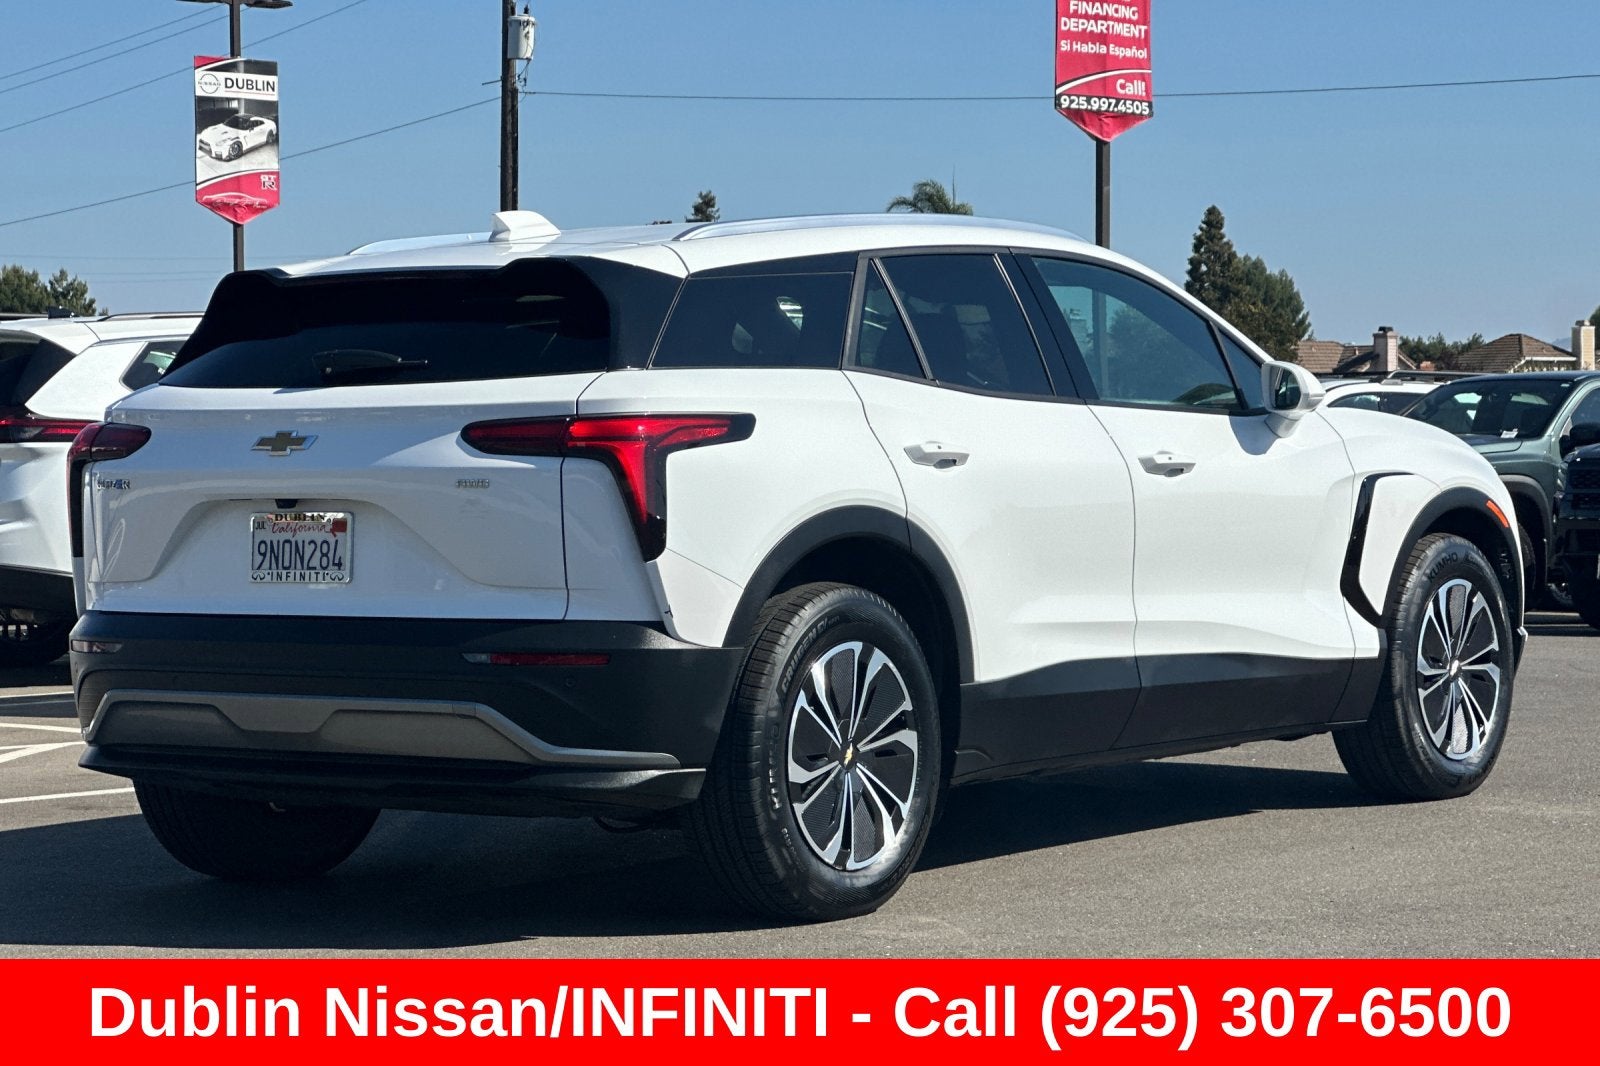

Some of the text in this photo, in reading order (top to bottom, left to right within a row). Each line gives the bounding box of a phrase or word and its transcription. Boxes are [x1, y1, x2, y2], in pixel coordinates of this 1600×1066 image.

[1069, 1, 1139, 20] FINANCING
[1060, 17, 1148, 39] DEPARTMENT
[1060, 40, 1148, 59] Si Habla Español
[224, 77, 276, 93] DUBLIN
[1116, 78, 1147, 97] Call!
[1060, 95, 1150, 115] 925.997.4505
[271, 522, 327, 538] California
[270, 572, 327, 581] INFINITI
